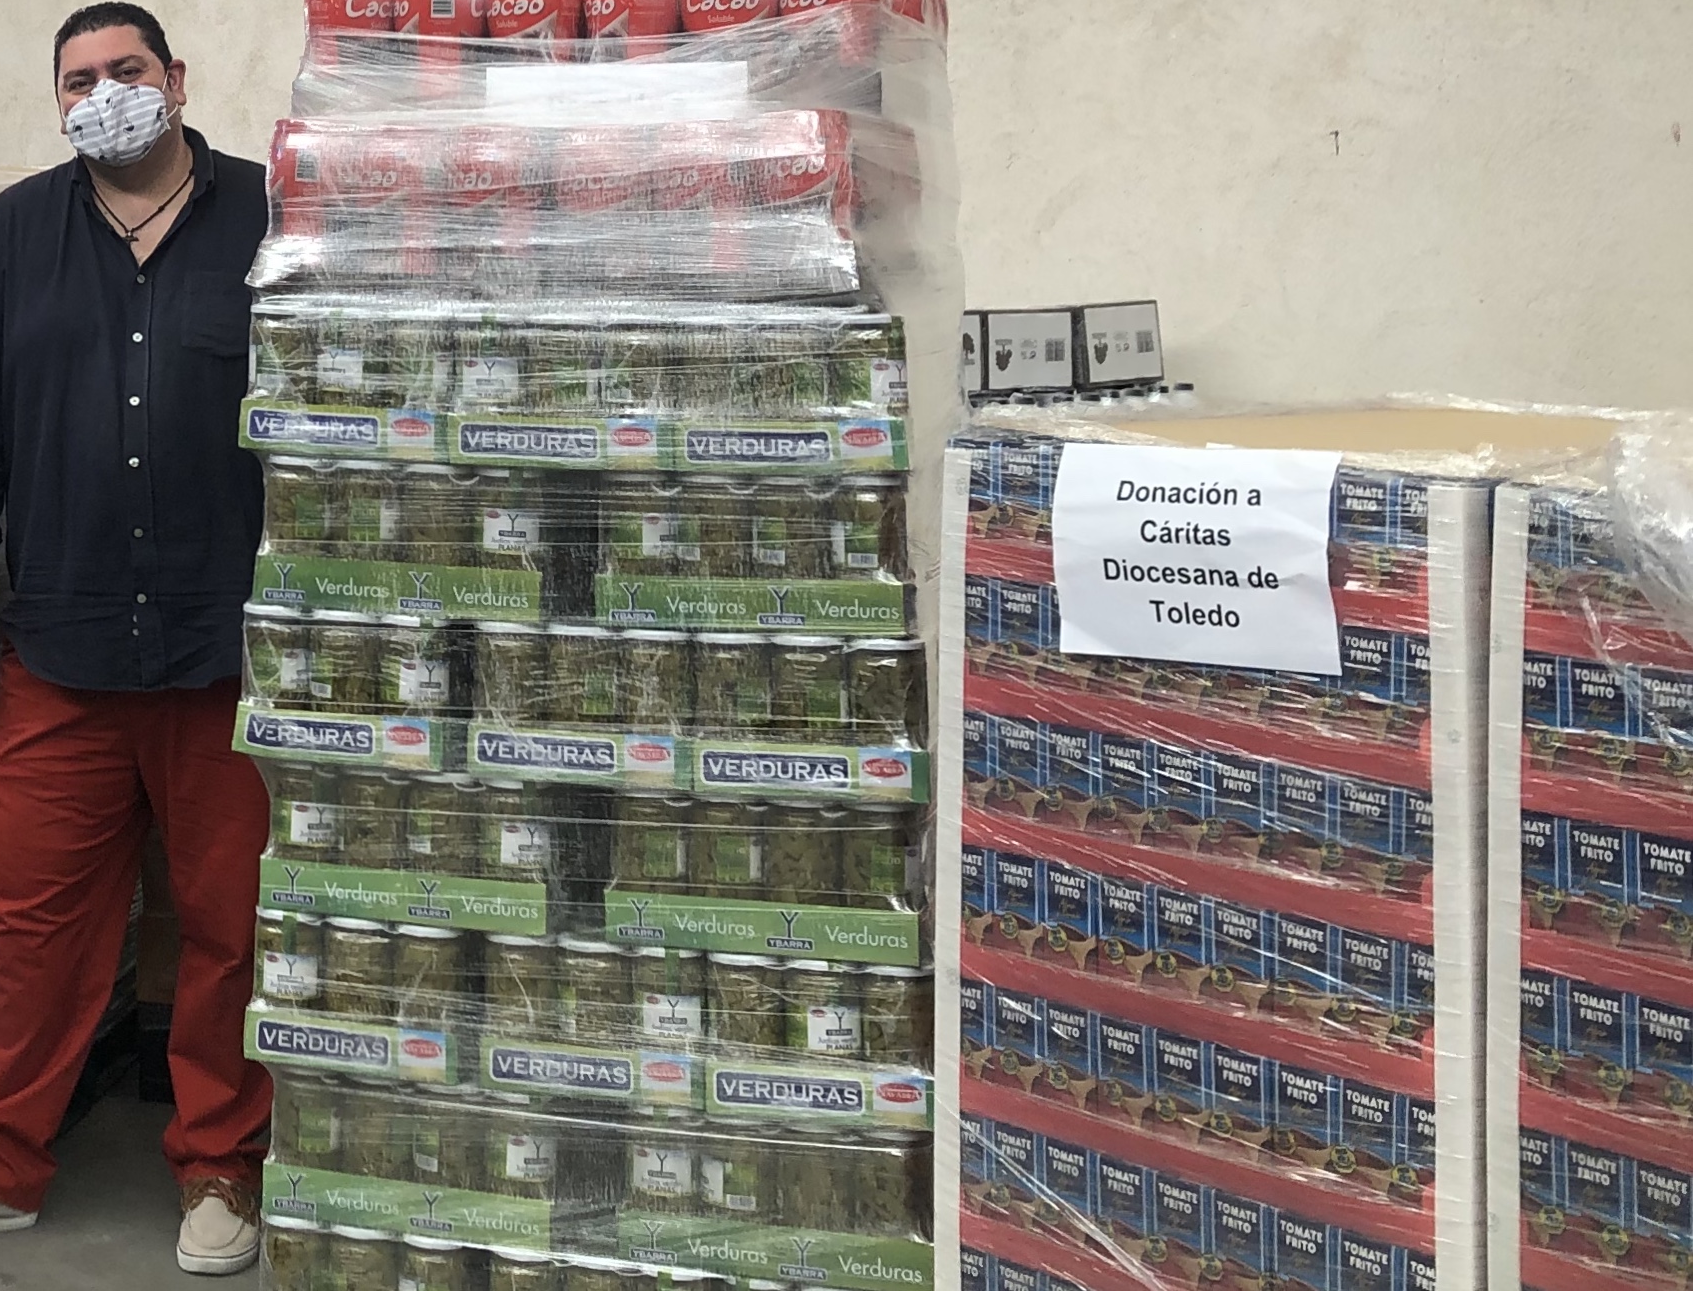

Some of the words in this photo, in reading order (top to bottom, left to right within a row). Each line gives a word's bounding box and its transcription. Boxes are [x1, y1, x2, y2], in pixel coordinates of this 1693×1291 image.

[253, 415, 374, 440] VERDURAS
[464, 429, 594, 452] VERDURAS
[691, 435, 825, 456] VERDURAS
[1116, 480, 1238, 505] Donación
[1247, 488, 1261, 506] a
[1341, 483, 1383, 498] TOMATE
[1346, 498, 1378, 511] FRITO
[1140, 520, 1231, 546] Cáritas
[1103, 558, 1239, 587] Diocesana
[1247, 566, 1279, 589] de
[266, 591, 304, 600] YBARRA
[315, 577, 390, 598] Verduras
[452, 586, 529, 608] Verduras
[402, 600, 440, 610] YBARRA
[666, 595, 746, 615] Verduras
[812, 599, 900, 619] Verduras
[1149, 600, 1240, 628] Toledo
[612, 612, 654, 622] YBARRA
[761, 615, 803, 625] YBARRA
[1345, 636, 1389, 652] TOMATE
[1350, 650, 1382, 664] FRITO
[1575, 668, 1621, 686] TOMATE
[1581, 684, 1615, 699] FRITO
[252, 720, 370, 748] VERDURAS
[481, 739, 611, 764] VERDURAS
[708, 758, 845, 780] VERDURAS
[1217, 762, 1257, 782] TOMATE
[1223, 778, 1252, 793] FRITO
[1280, 773, 1323, 791] TOMATE
[1285, 788, 1317, 803] FRITO
[1343, 788, 1387, 806] TOMATE
[1349, 802, 1381, 817] FRITO
[1573, 830, 1619, 850] TOMATE
[1581, 847, 1613, 863] FRITO
[1643, 842, 1691, 864] TOMATE
[999, 860, 1033, 878] TOMATE
[1650, 858, 1684, 876] FRITO
[1003, 874, 1028, 888] FRITO
[1049, 871, 1086, 889] TOMATE
[273, 893, 313, 905] YBARRA
[324, 881, 398, 905] Verduras
[1054, 884, 1081, 900] FRITO
[409, 908, 449, 919] YBARRA
[461, 895, 539, 919] Verduras
[1160, 896, 1199, 915] TOMATE
[675, 913, 755, 937] Verduras
[1165, 911, 1193, 926] FRITO
[1217, 910, 1257, 929] TOMATE
[620, 927, 662, 939] YBARRA
[825, 924, 908, 948] Verduras
[1223, 925, 1252, 940] FRITO
[1281, 922, 1323, 942] TOMATE
[769, 939, 812, 950] YBARRA
[1287, 938, 1317, 954] FRITO
[1345, 938, 1389, 960] TOMATE
[1351, 956, 1382, 972] FRITO
[1573, 992, 1620, 1013] TOMATE
[1049, 1008, 1085, 1028] TOMATE
[1580, 1008, 1613, 1025] FRITO
[1643, 1008, 1691, 1030] TOMATE
[1054, 1022, 1081, 1038] FRITO
[1103, 1024, 1140, 1044] TOMATE
[1649, 1024, 1683, 1042] FRITO
[262, 1027, 386, 1058] VERDURAS
[1107, 1040, 1135, 1055] FRITO
[1159, 1040, 1199, 1060] TOMATE
[497, 1056, 627, 1084] VERDURAS
[1164, 1055, 1193, 1070] FRITO
[1217, 1055, 1258, 1076] TOMATE
[1223, 1071, 1252, 1087] FRITO
[1281, 1072, 1323, 1093] TOMATE
[721, 1078, 858, 1106] VERDURAS
[1287, 1088, 1317, 1105] FRITO
[1346, 1089, 1391, 1112] TOMATE
[1351, 1106, 1383, 1123] FRITO
[1048, 1146, 1085, 1166] TOMATE
[1571, 1151, 1617, 1174] TOMATE
[1053, 1160, 1079, 1177] FRITO
[1103, 1164, 1140, 1186] TOMATE
[1577, 1168, 1610, 1186] FRITO
[1107, 1180, 1135, 1196] FRITO
[1640, 1170, 1688, 1195] TOMATE
[326, 1189, 400, 1216] Verduras
[1159, 1182, 1198, 1204] TOMATE
[1647, 1186, 1681, 1206] FRITO
[274, 1199, 315, 1212] YBARRA
[1163, 1198, 1193, 1214] FRITO
[1217, 1200, 1257, 1224] TOMATE
[411, 1219, 452, 1231] YBARRA
[463, 1208, 540, 1235] Verduras
[1223, 1216, 1252, 1234] FRITO
[1280, 1220, 1323, 1244] TOMATE
[687, 1238, 768, 1264] Verduras
[1285, 1235, 1317, 1254] FRITO
[1343, 1240, 1389, 1264] TOMATE
[631, 1250, 674, 1262] YBARRA
[782, 1267, 825, 1280] YBARRA
[838, 1255, 923, 1284] Verduras
[1349, 1257, 1381, 1276] FRITO
